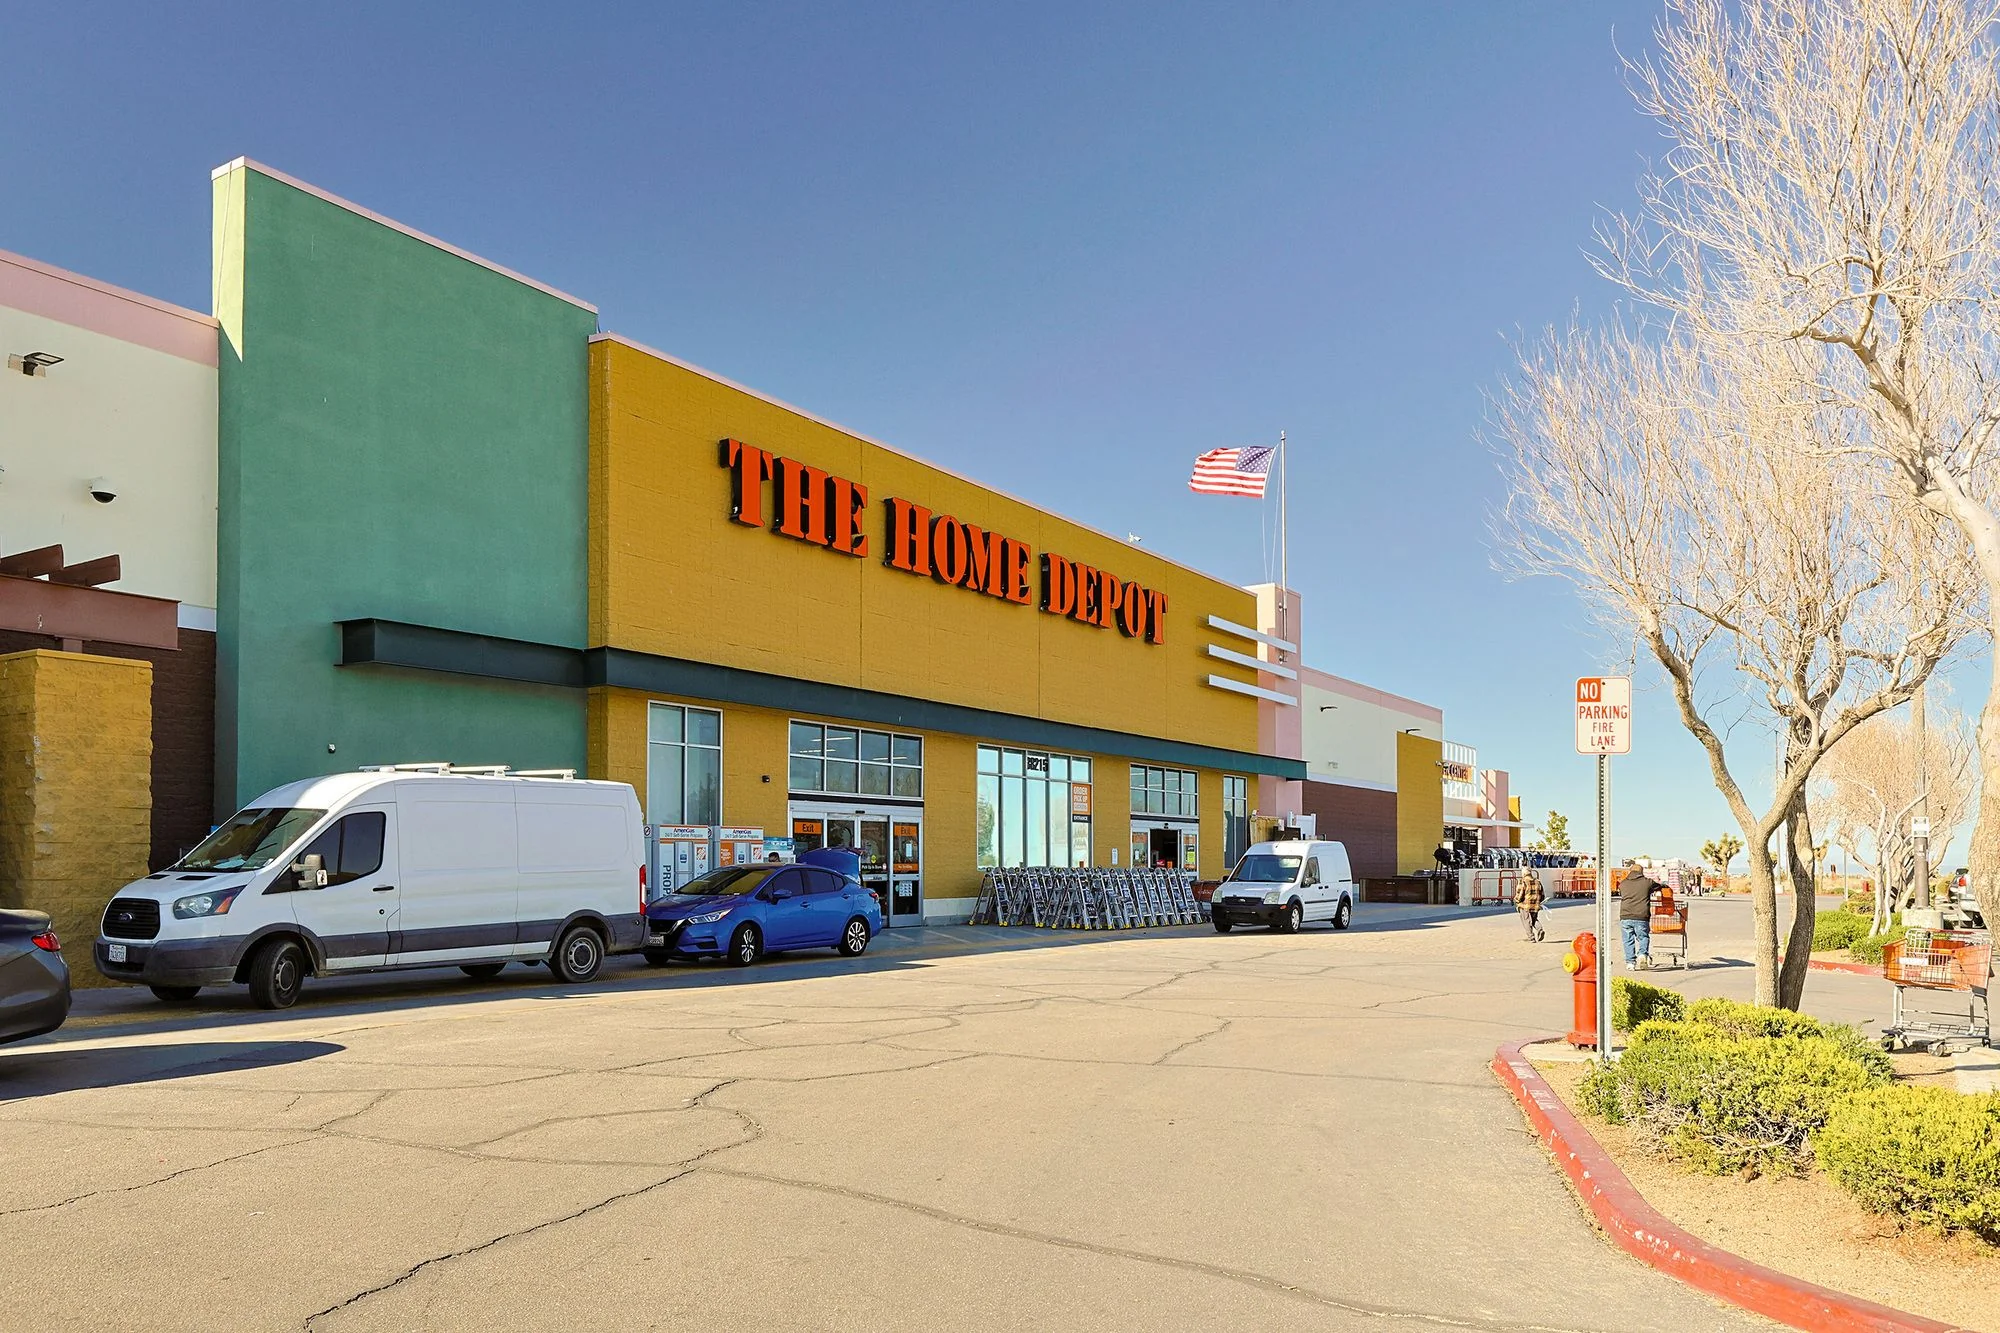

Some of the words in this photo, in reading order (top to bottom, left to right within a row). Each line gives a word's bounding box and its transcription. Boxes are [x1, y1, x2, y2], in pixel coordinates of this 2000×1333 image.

[720, 437, 868, 558] THE
[884, 496, 1032, 605] HOME
[1040, 552, 1168, 645] DEPOT
[1580, 682, 1598, 700] NO
[1579, 705, 1628, 720] PARKING
[1592, 721, 1614, 733] FIRE
[1590, 735, 1616, 747] LANE
[802, 823, 814, 833] Exit
